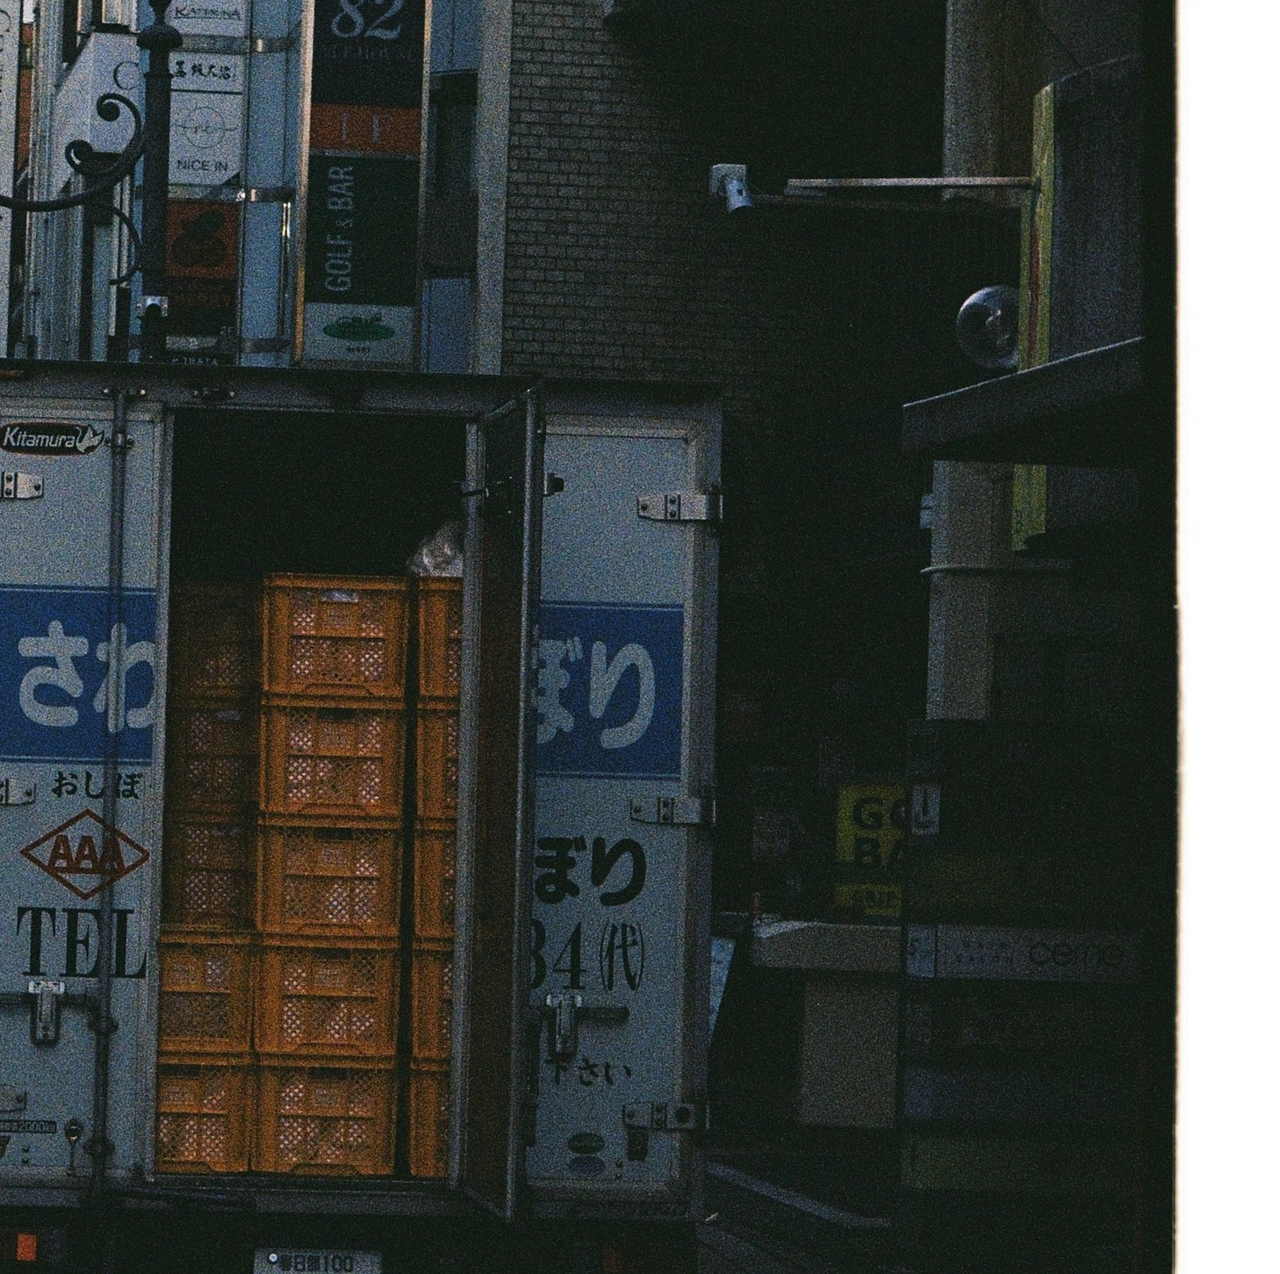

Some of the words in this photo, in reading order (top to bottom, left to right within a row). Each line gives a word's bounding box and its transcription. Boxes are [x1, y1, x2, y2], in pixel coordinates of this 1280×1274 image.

[327, 164, 355, 211] BAR
[341, 216, 354, 229] &
[325, 232, 353, 292] GOLF
[2, 425, 77, 449] Kitamura
[18, 620, 158, 735] さわ
[47, 833, 126, 875] AAA
[16, 906, 148, 979] TEL
